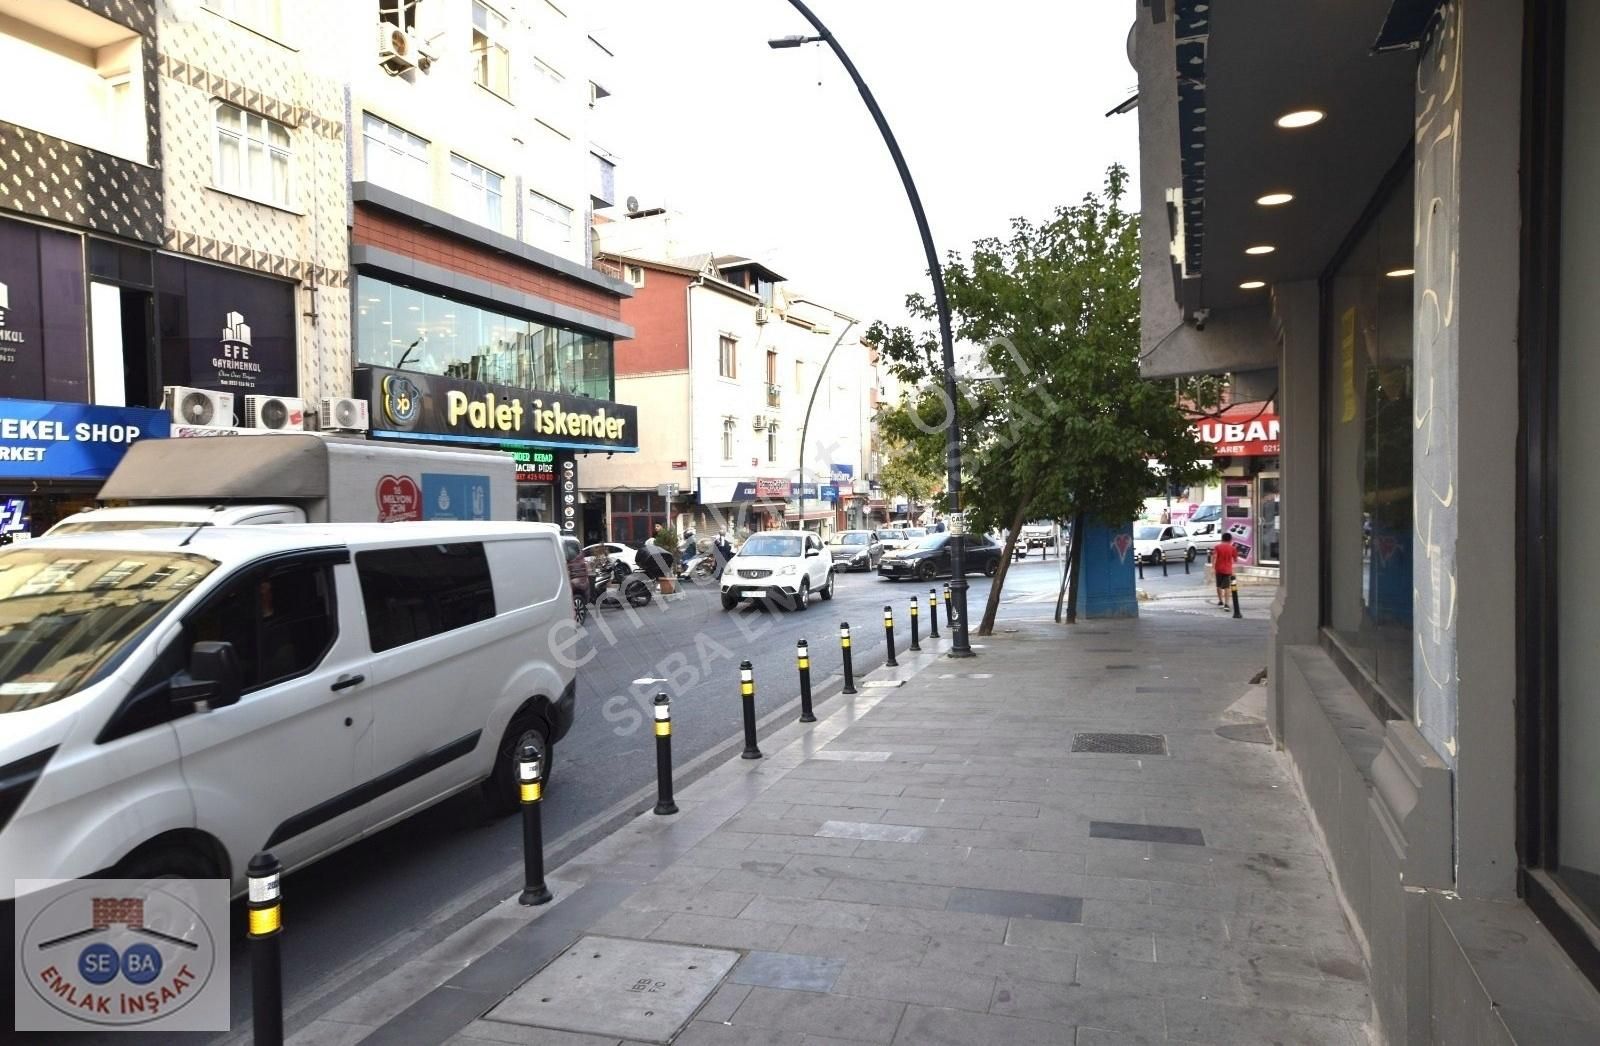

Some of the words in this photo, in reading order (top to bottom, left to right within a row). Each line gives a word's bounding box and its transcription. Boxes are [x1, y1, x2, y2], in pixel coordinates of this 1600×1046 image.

[224, 344, 249, 360] EFE
[447, 391, 524, 432] Palet
[533, 399, 626, 440] iskender
[0, 418, 70, 441] EKEL
[75, 422, 141, 443] SHOP
